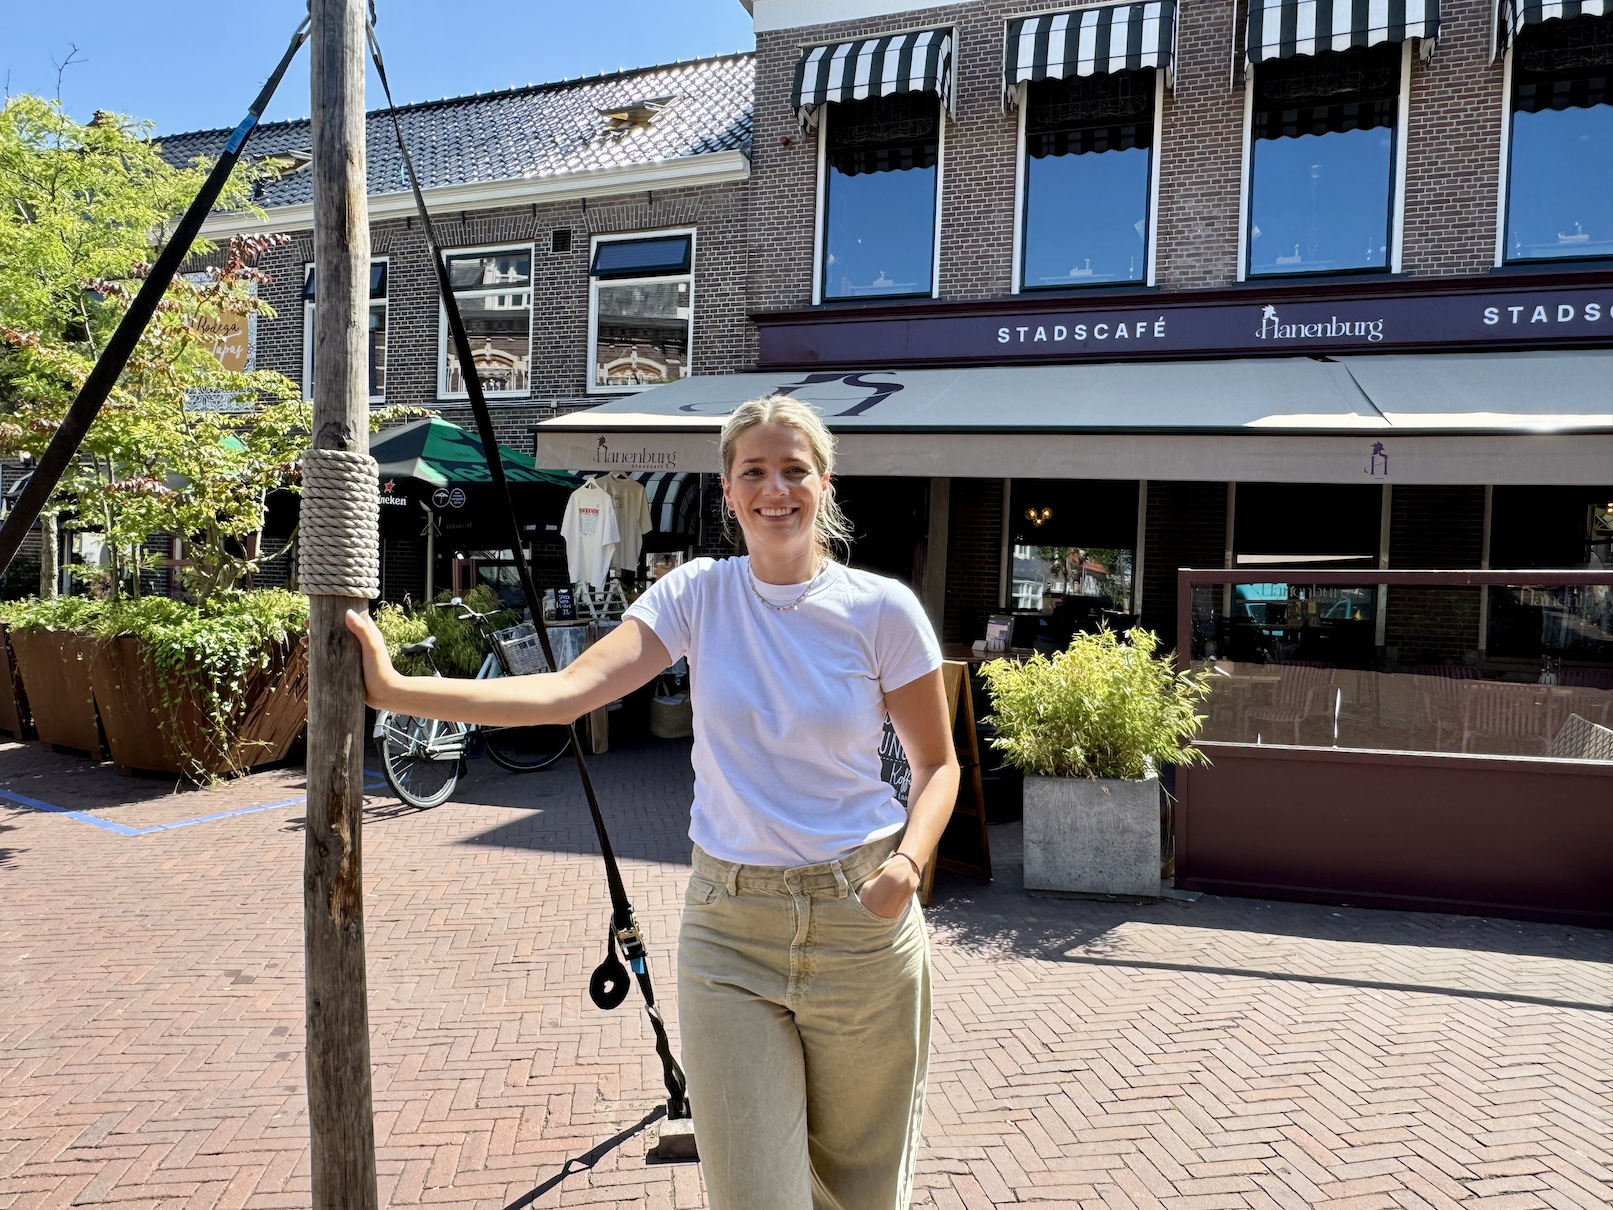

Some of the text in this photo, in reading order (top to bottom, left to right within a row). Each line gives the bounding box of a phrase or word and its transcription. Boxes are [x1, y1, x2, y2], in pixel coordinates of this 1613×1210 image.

[997, 303, 1613, 343] STADSCAFÉ Hanenburg STADS
[593, 444, 676, 469] Hanenburg
